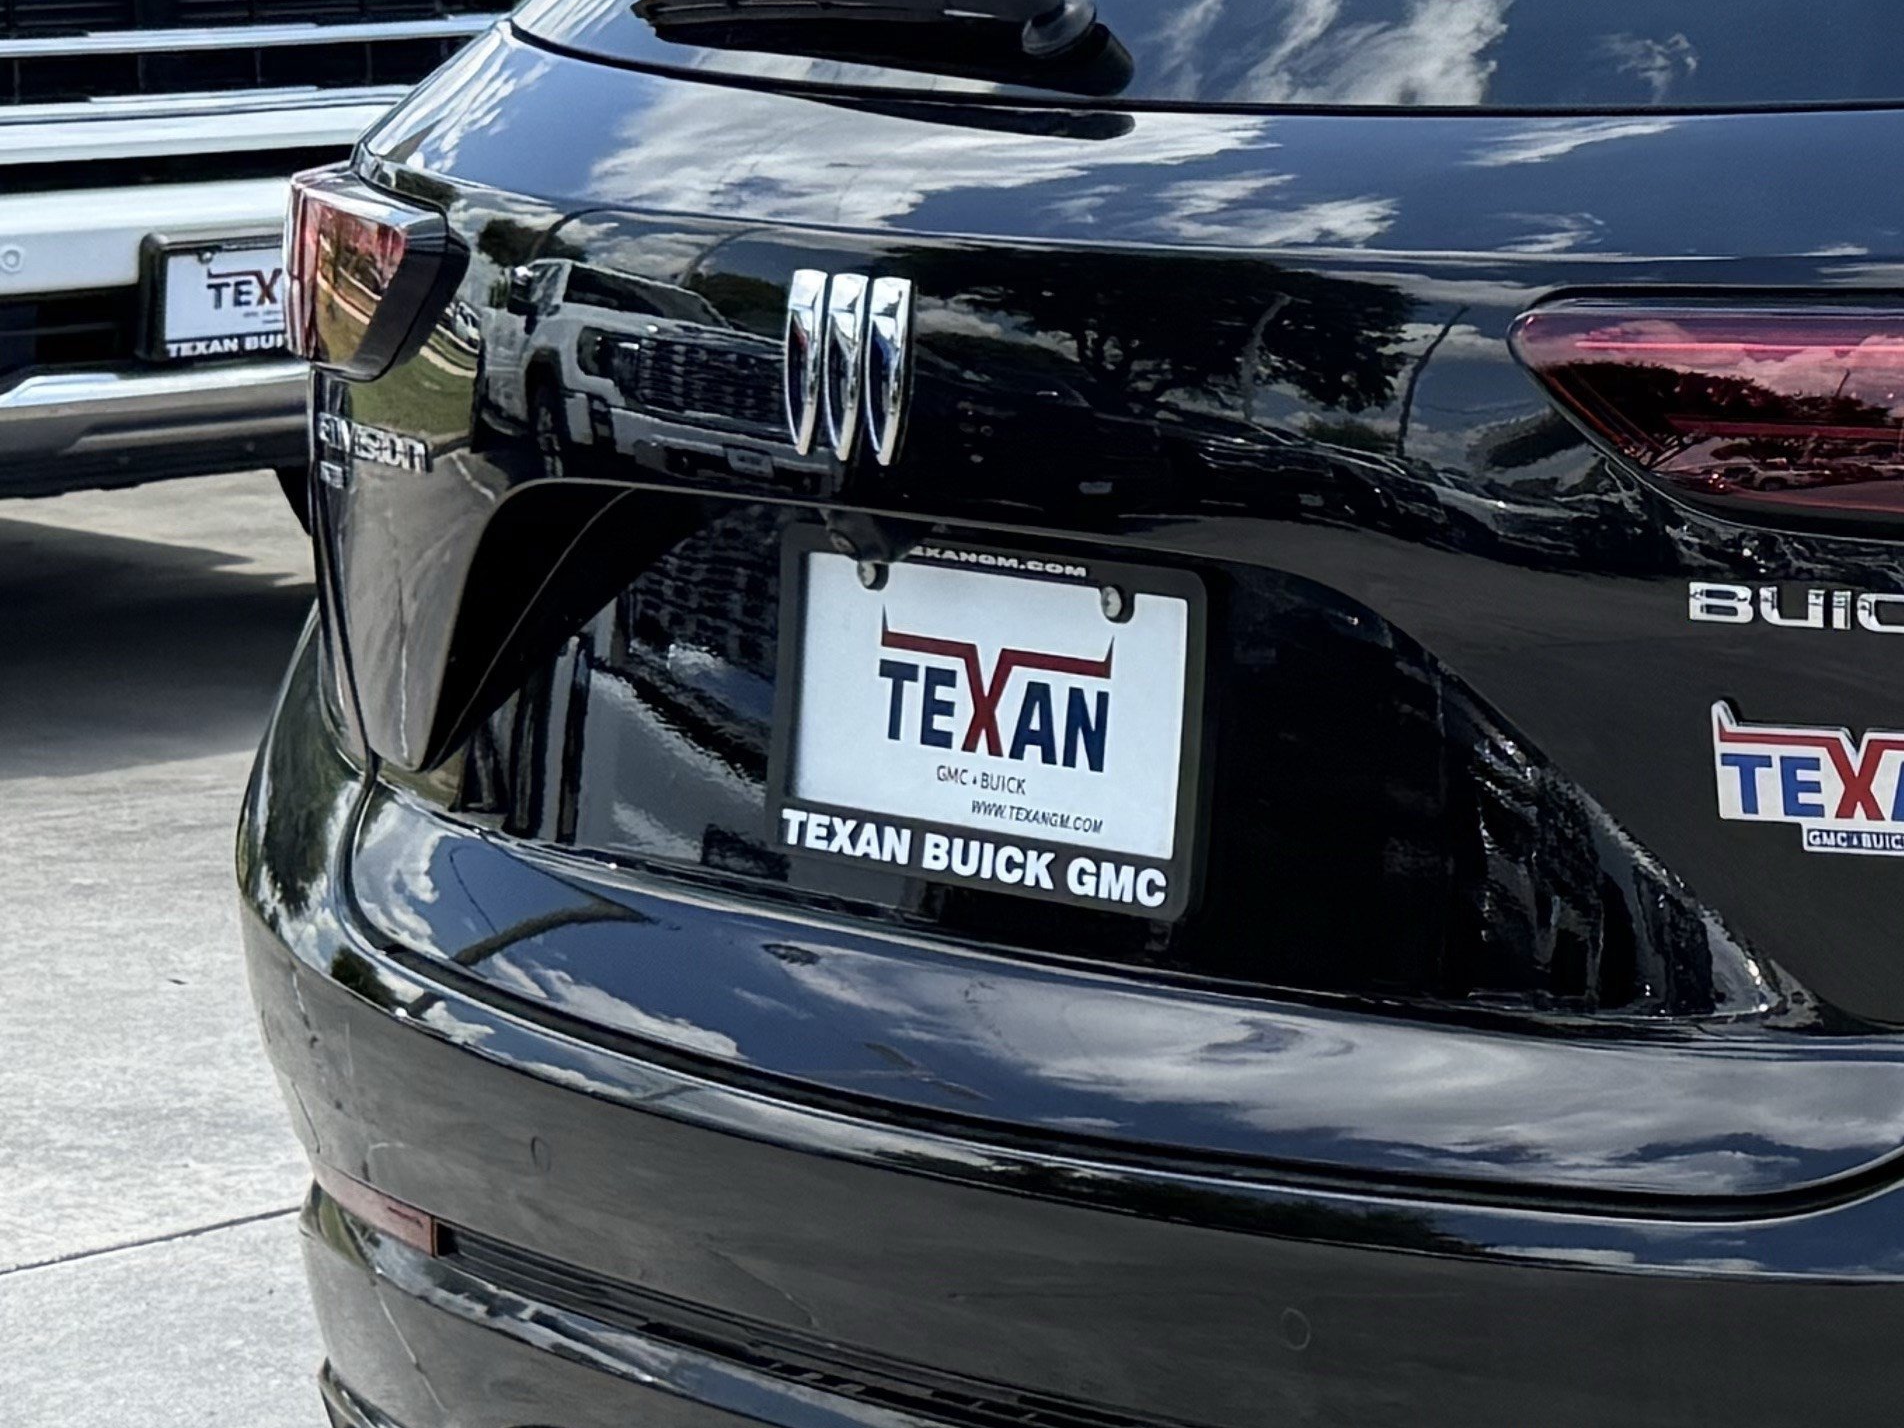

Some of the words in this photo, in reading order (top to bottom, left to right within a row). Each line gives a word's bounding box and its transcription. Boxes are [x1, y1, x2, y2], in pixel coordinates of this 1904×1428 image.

[207, 269, 283, 310] TEX
[167, 338, 238, 358] TEXAN
[245, 334, 285, 351] BUI
[879, 643, 1110, 773] TEXAN
[937, 765, 968, 785] GMC
[980, 772, 1026, 795] BUICK
[1808, 830, 1848, 847] GMC
[782, 808, 911, 865] TEXAN
[922, 833, 1055, 889] BUICK
[1067, 857, 1167, 907] GMC
